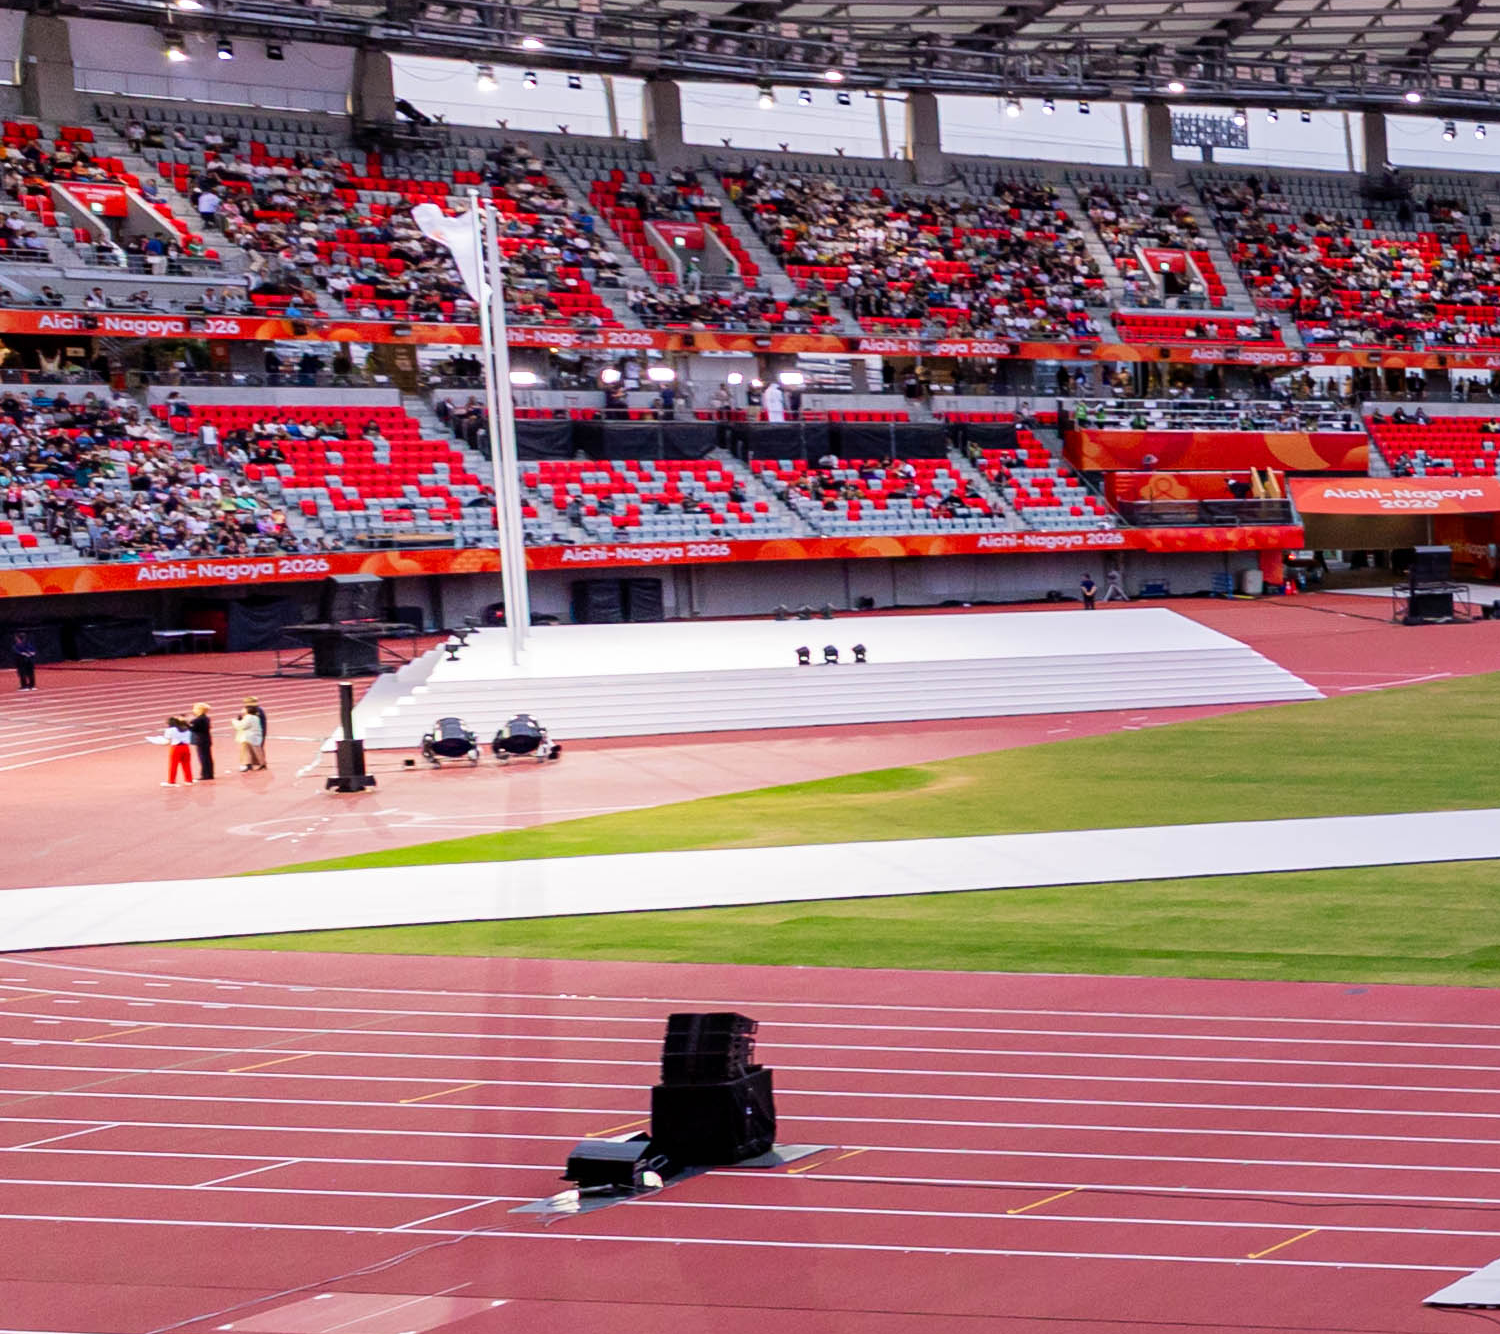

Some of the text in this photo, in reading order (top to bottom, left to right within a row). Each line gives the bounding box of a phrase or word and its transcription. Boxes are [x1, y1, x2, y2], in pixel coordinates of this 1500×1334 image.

[38, 314, 184, 336] Aich-Nagoya
[608, 333, 654, 345] 2026
[859, 339, 968, 355] Aichi-Ngoya
[1324, 488, 1484, 500] Aichi-Nagoya
[1379, 499, 1438, 508] 2026
[978, 532, 1124, 548] Aichi-Nagoya 2026
[561, 544, 731, 561] Aichi-Nagoya 2026
[137, 558, 331, 581] Aichi-Nagoya 2026
